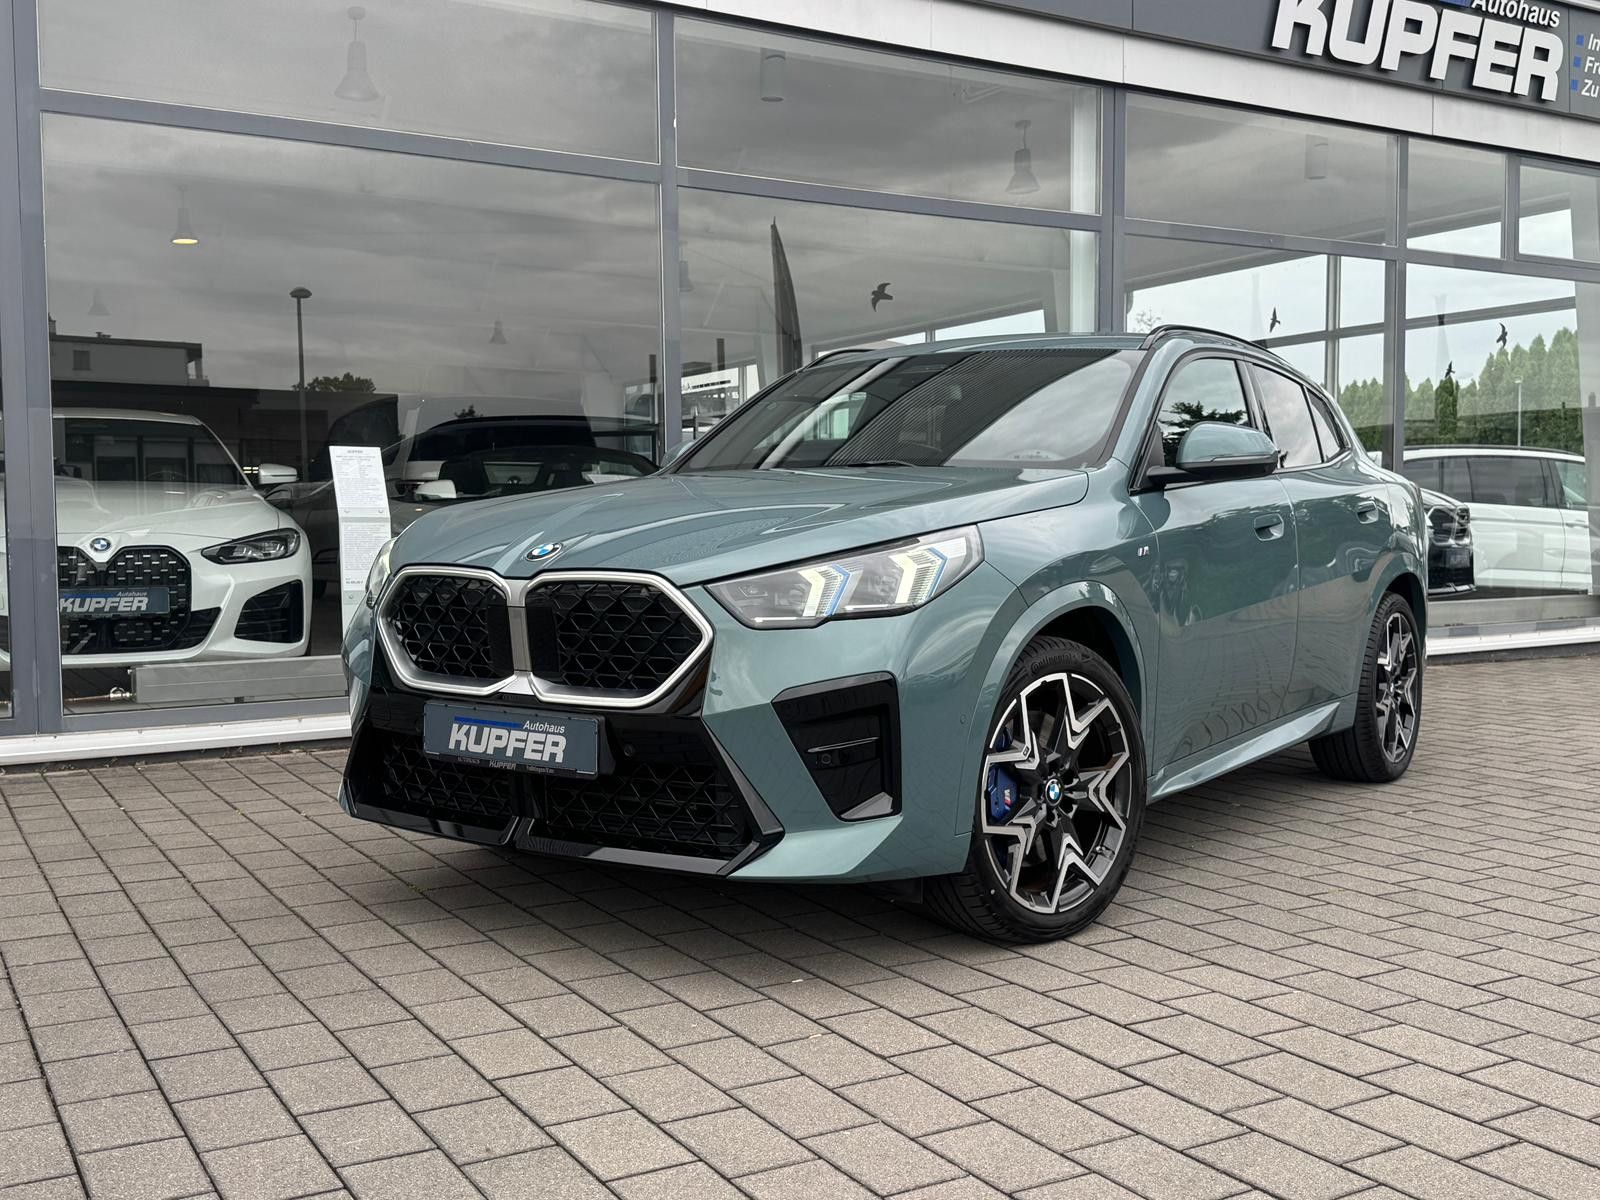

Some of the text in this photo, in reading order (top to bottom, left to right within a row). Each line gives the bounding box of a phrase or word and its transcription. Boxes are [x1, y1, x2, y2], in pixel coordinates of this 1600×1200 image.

[1271, 0, 1564, 102] KUPFER
[1584, 56, 1600, 75] Fr
[60, 597, 148, 612] KUPFER
[523, 720, 565, 733] Autohaus
[448, 723, 567, 763] KUPFER
